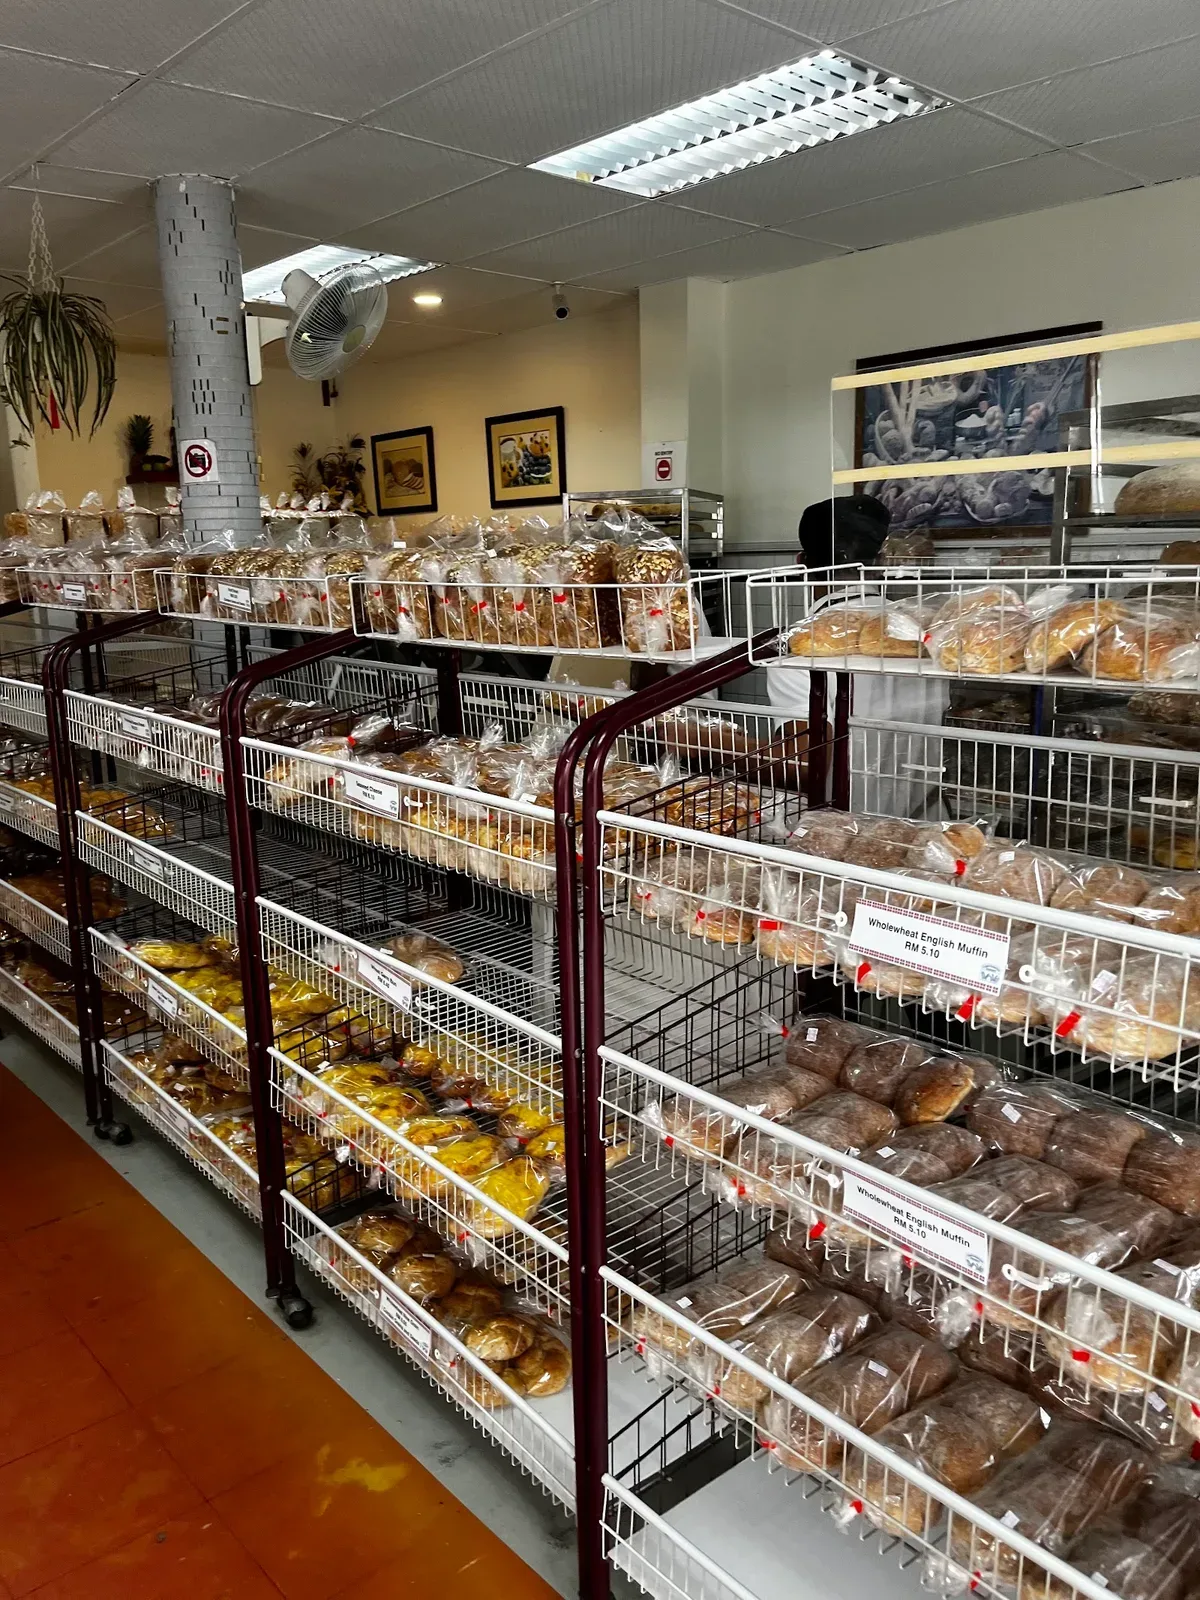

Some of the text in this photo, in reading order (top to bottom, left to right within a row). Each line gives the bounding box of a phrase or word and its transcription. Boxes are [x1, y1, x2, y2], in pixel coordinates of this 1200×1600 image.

[868, 917, 988, 959] Wholewheat English Muffin
[904, 941, 940, 959] RM 5.10
[857, 1185, 970, 1248] Wholewheat English Muffin
[893, 1216, 927, 1239] RM 5.10
